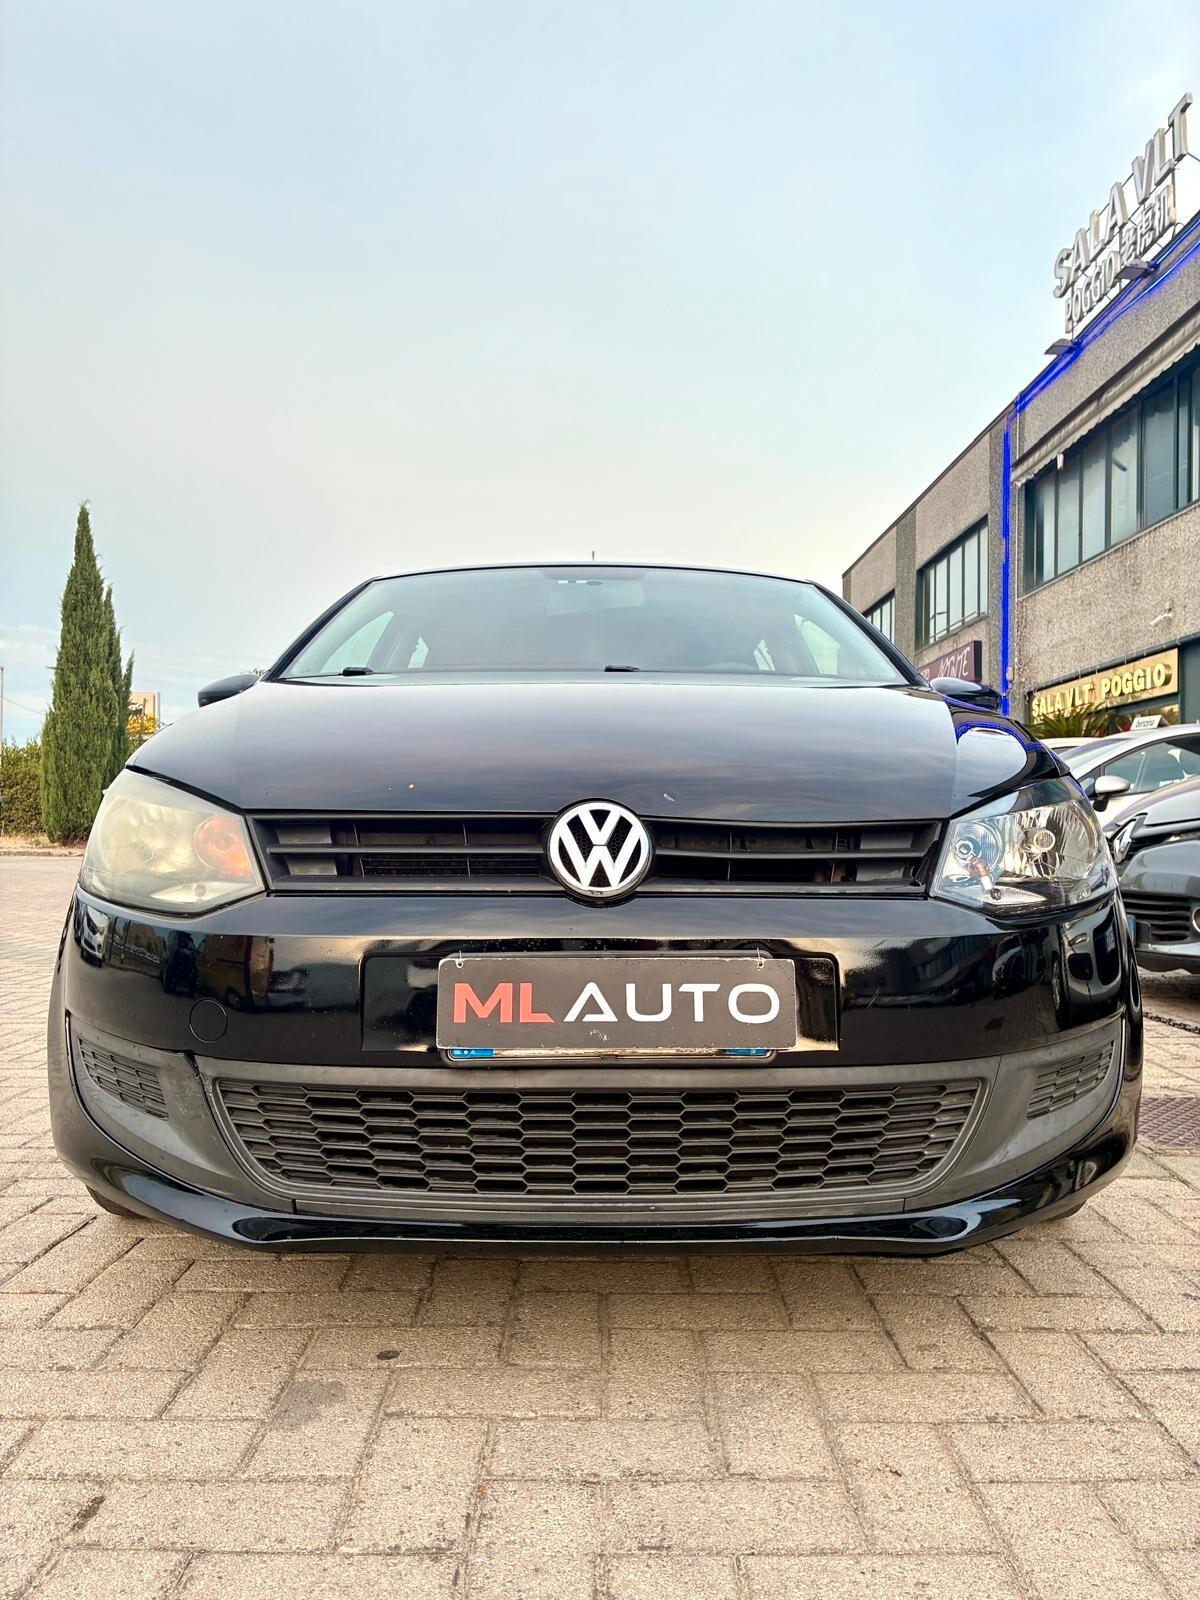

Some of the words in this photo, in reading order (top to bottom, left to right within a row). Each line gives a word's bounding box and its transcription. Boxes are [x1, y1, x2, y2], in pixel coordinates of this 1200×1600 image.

[1053, 182, 1129, 298] SALA
[1132, 92, 1193, 204] VLT
[1065, 251, 1120, 333] POGGIO
[1101, 663, 1166, 699] POGGIO
[552, 803, 648, 891] VW
